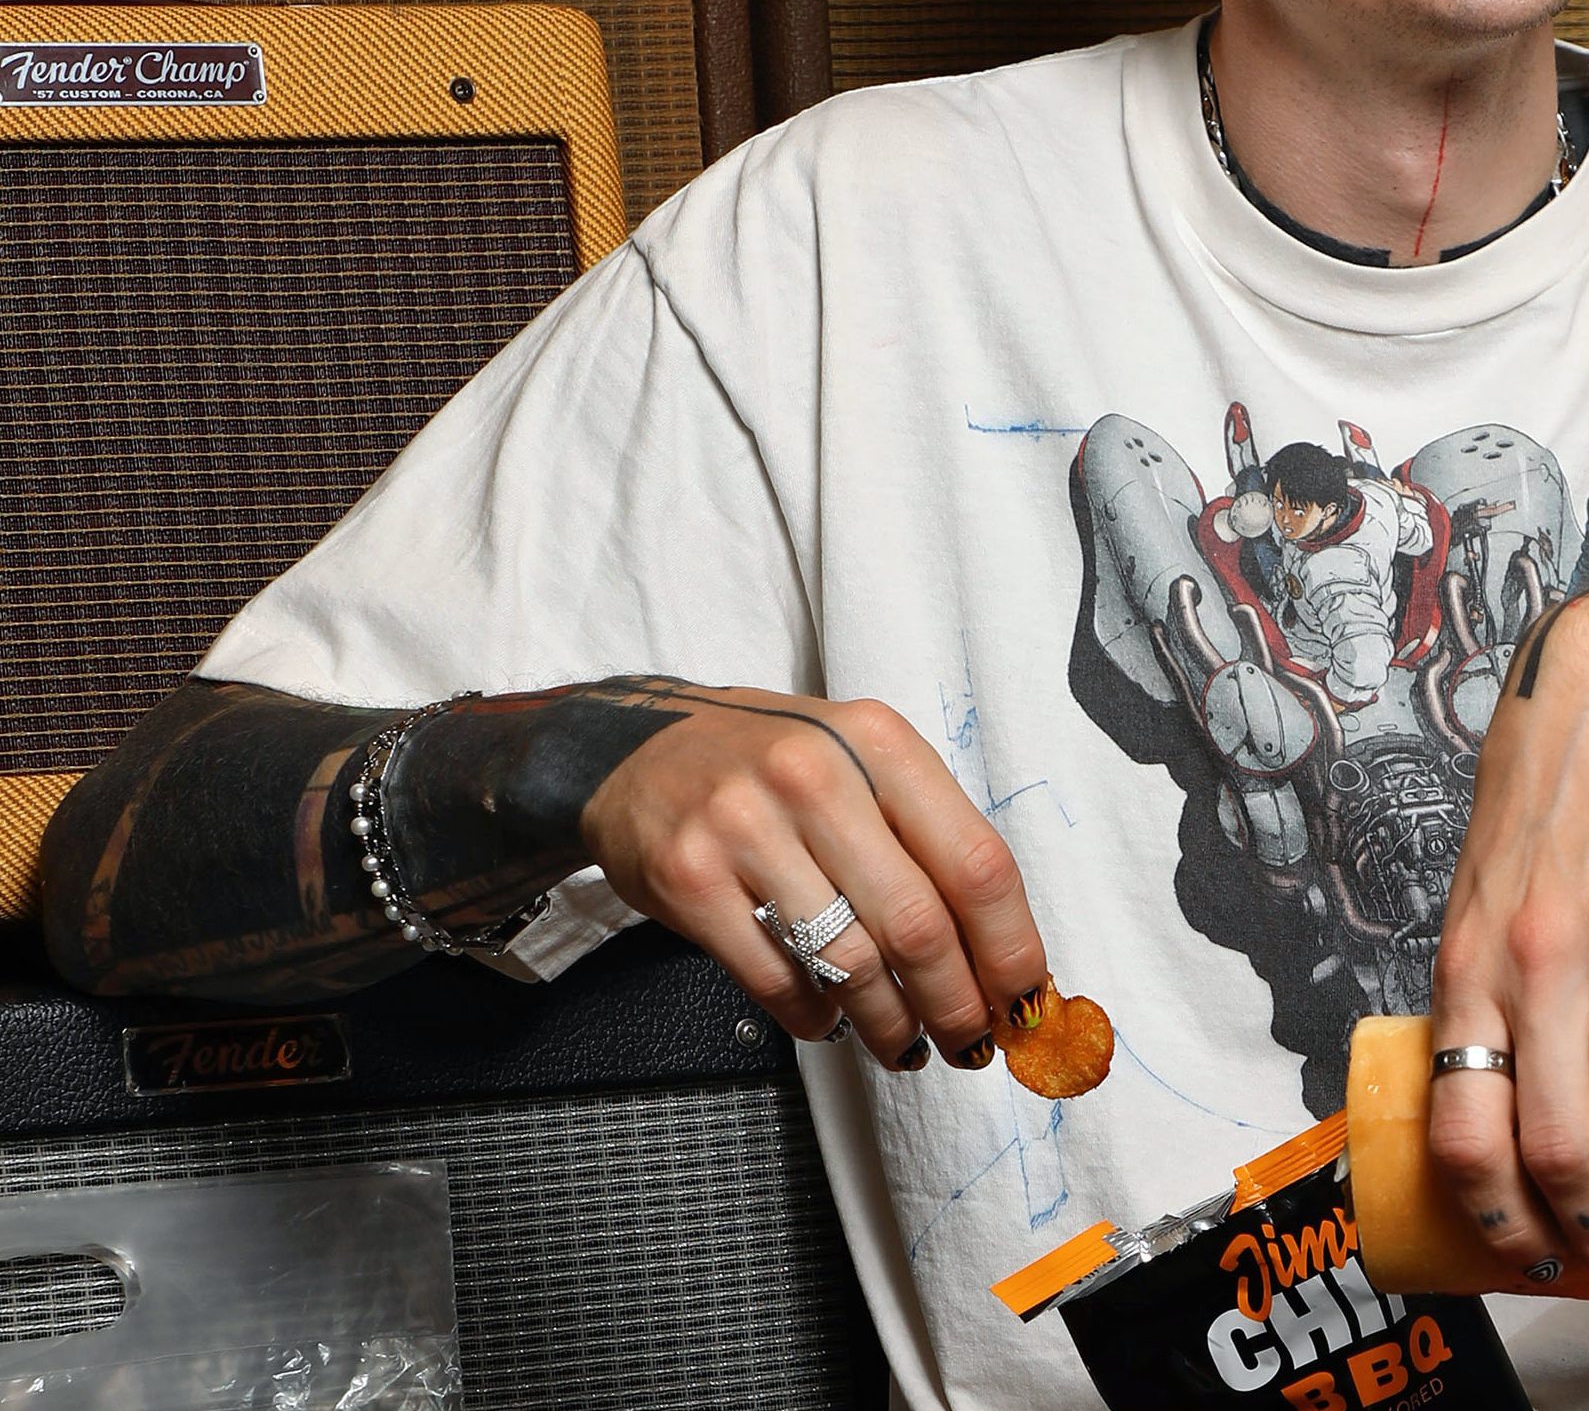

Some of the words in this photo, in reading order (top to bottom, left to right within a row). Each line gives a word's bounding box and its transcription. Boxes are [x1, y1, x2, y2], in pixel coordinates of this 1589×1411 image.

[33, 90, 54, 99] '57
[59, 89, 121, 99] CUSTOM
[135, 49, 247, 90] Champ
[148, 1027, 323, 1086] Fender
[1207, 1255, 1407, 1392] CHI
